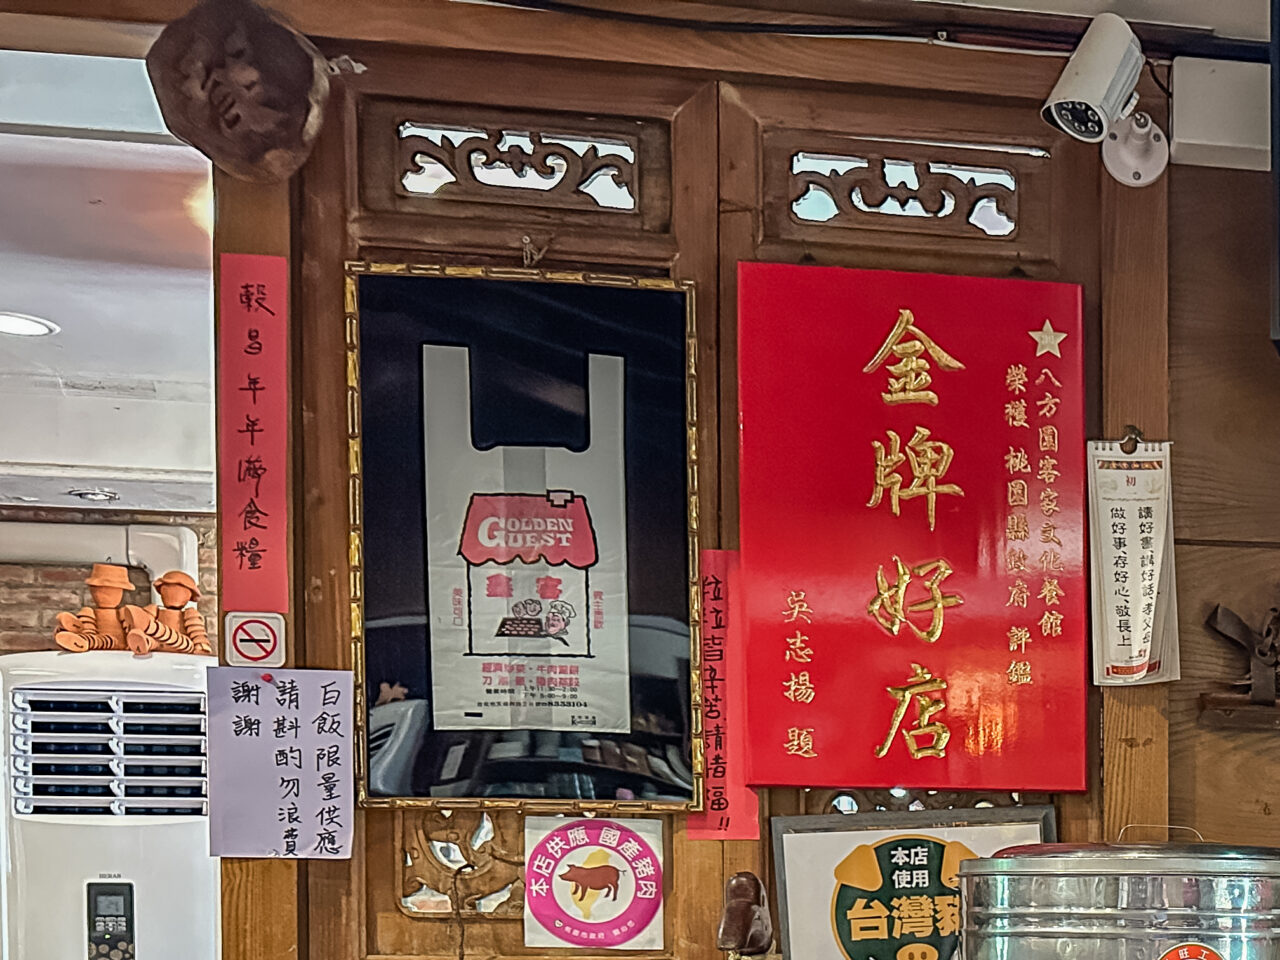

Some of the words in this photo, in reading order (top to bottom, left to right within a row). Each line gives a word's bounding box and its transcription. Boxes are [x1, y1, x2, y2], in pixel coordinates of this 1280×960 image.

[862, 308, 966, 761] 金牌好店
[781, 590, 817, 704] 吳志揚
[231, 680, 262, 737] 謝謝
[783, 726, 818, 758] 題
[272, 679, 303, 857] 請斟酌勿浪費
[311, 681, 345, 856] 白飯限量供應
[530, 826, 590, 897] 本店供應
[890, 846, 929, 866] 本店
[892, 869, 930, 889] 使用
